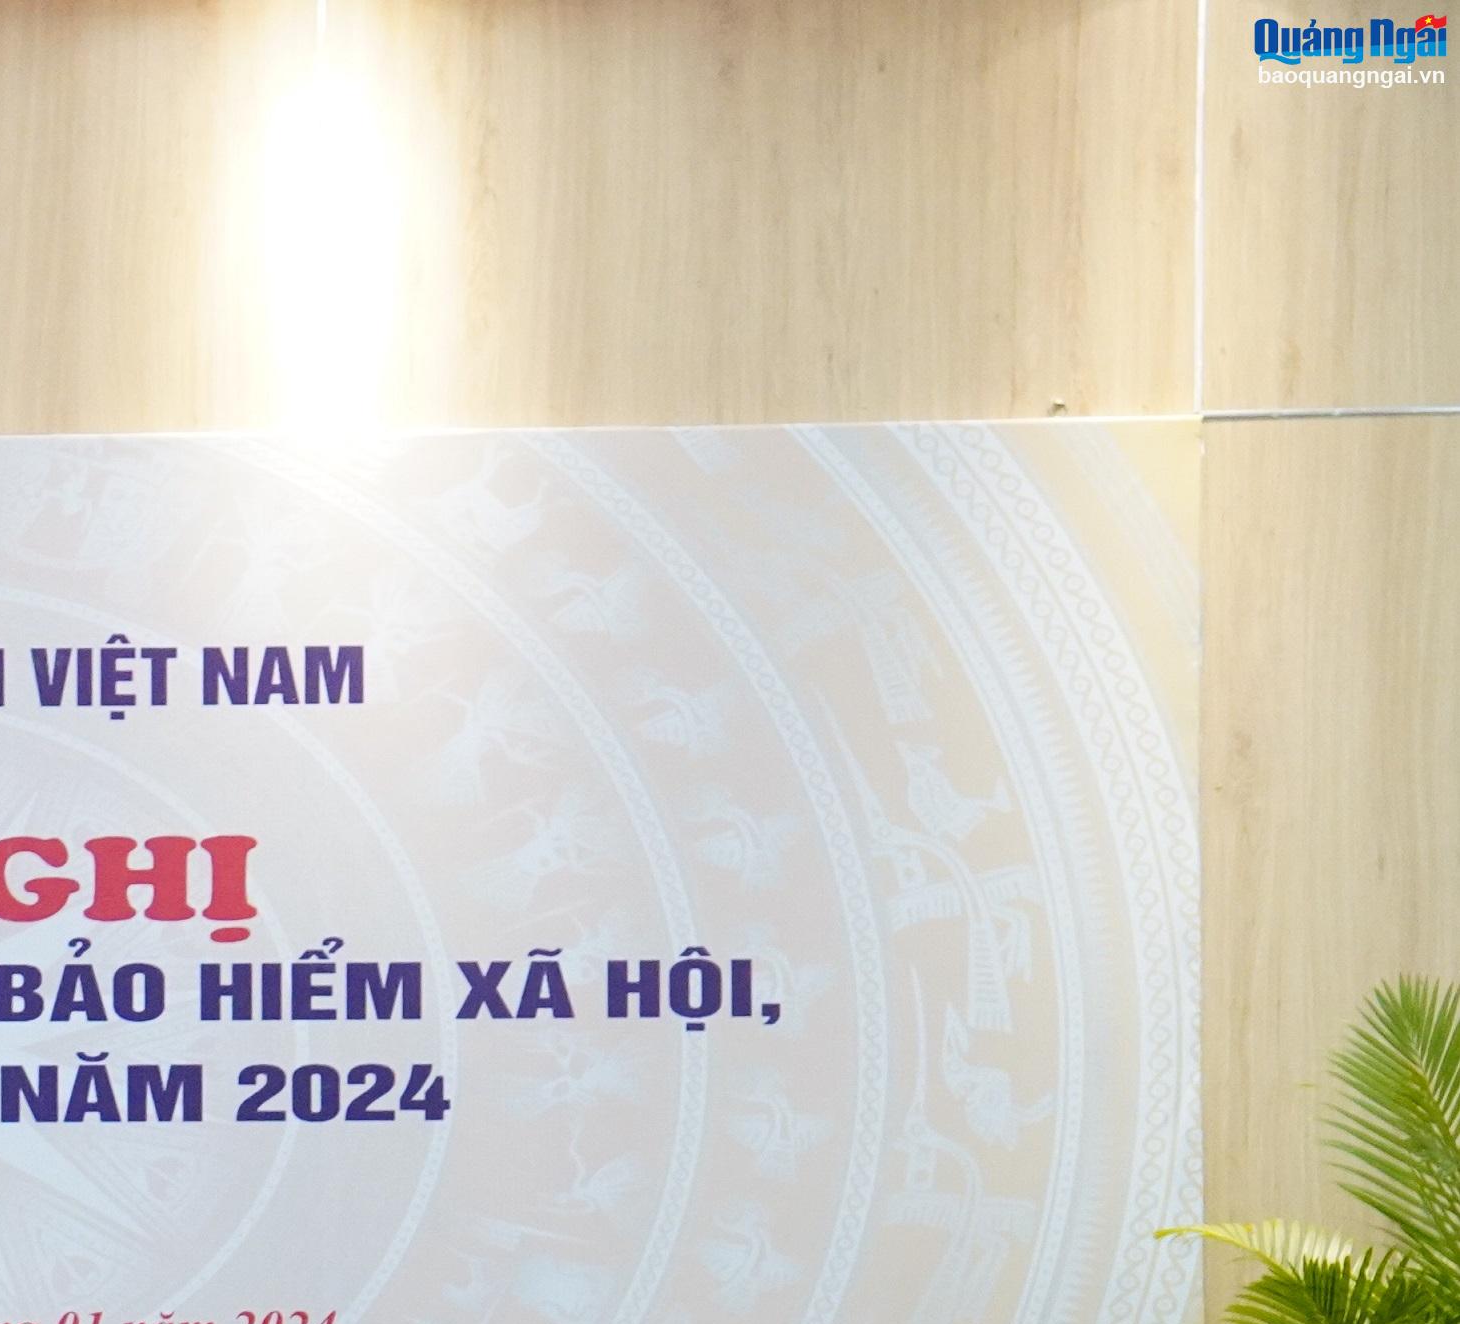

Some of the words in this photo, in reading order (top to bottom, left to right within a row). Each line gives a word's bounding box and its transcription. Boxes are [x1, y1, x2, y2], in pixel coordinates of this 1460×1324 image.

[30, 634, 177, 721] VIỆT
[202, 646, 364, 706] NAM
[200, 935, 422, 1021] HIỂM
[455, 947, 574, 1020] XÃ
[607, 946, 781, 1033] HỘI,
[0, 1050, 204, 1123] NĂM
[235, 1062, 451, 1123] 2024
